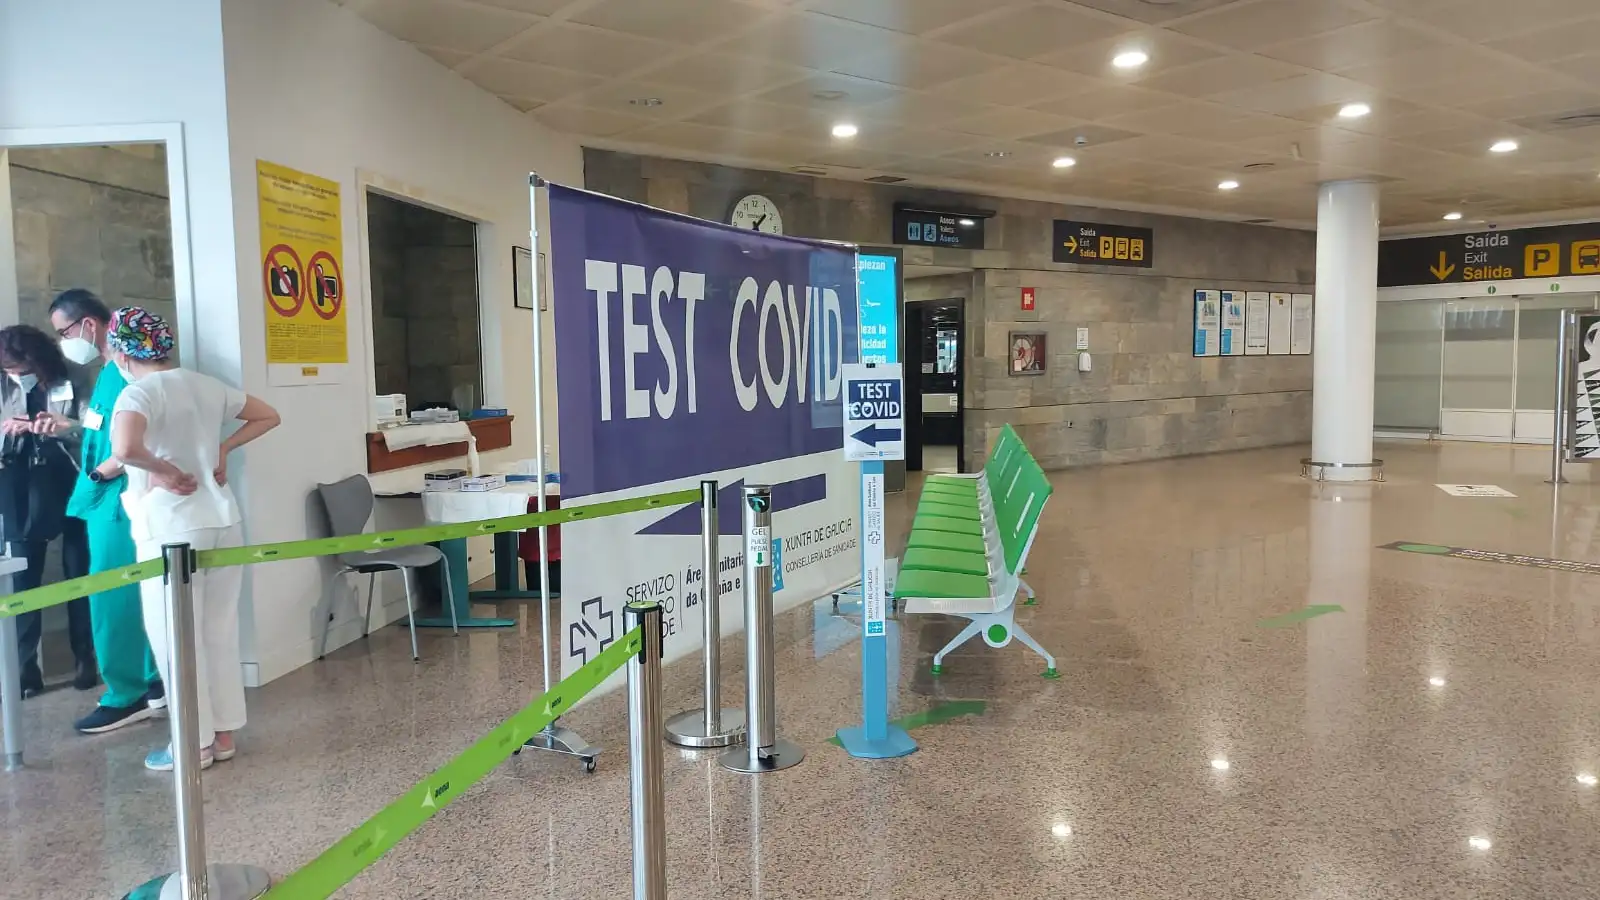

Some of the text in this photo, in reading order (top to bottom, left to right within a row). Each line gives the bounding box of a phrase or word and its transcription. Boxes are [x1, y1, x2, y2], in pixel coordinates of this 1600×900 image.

[752, 200, 758, 208] 12
[736, 210, 744, 219] 10
[940, 216, 955, 225] Aseos
[772, 225, 777, 233] 3
[940, 234, 959, 243] Aseos
[1464, 233, 1509, 249] Saída
[1080, 249, 1097, 258] Salida
[1103, 240, 1110, 256] P
[1464, 252, 1489, 264] Exit
[1532, 249, 1551, 271] P
[1463, 266, 1513, 280] Salida
[585, 259, 842, 422] TEST COVID
[858, 383, 892, 399] TEST
[850, 401, 900, 418] COVID
[751, 528, 767, 536] GEL
[785, 530, 812, 553] XUNTA
[814, 527, 824, 543] DE
[825, 518, 852, 539] GALICIA
[824, 547, 832, 559] DE
[832, 538, 856, 555] SANIDADE
[686, 562, 702, 585] Áre
[626, 573, 675, 605] SERVIZO
[735, 577, 741, 590] e
[686, 591, 698, 608] da
[435, 781, 450, 799] aena
